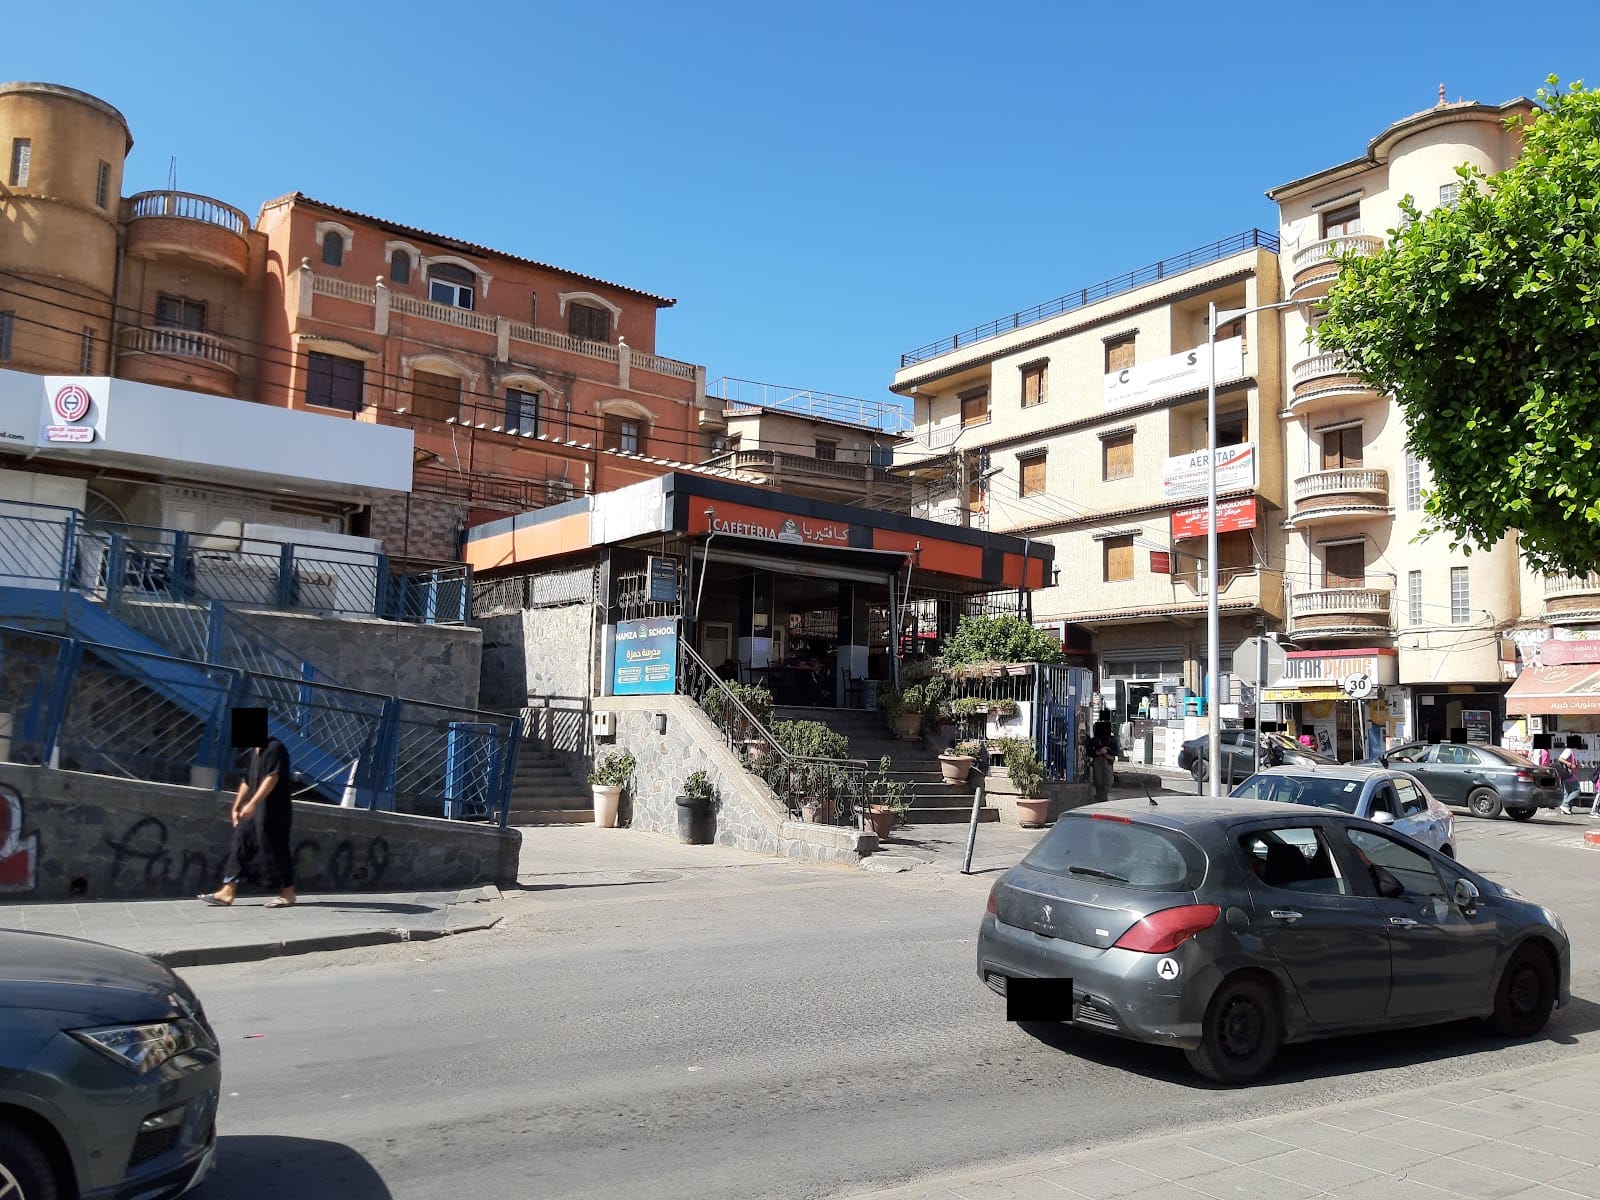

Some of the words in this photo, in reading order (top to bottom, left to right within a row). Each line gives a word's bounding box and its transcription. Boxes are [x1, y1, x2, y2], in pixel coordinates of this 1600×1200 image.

[1189, 449, 1236, 469] AERTAP
[713, 518, 777, 540] CAFÉTÉRIA
[802, 521, 849, 541] كافتيريا
[616, 631, 638, 641] HAMZA
[648, 626, 675, 637] SCHOOL
[626, 650, 641, 660] حمزة
[642, 648, 661, 658] مدرسة
[1350, 680, 1366, 690] 30
[1160, 959, 1175, 975] A
